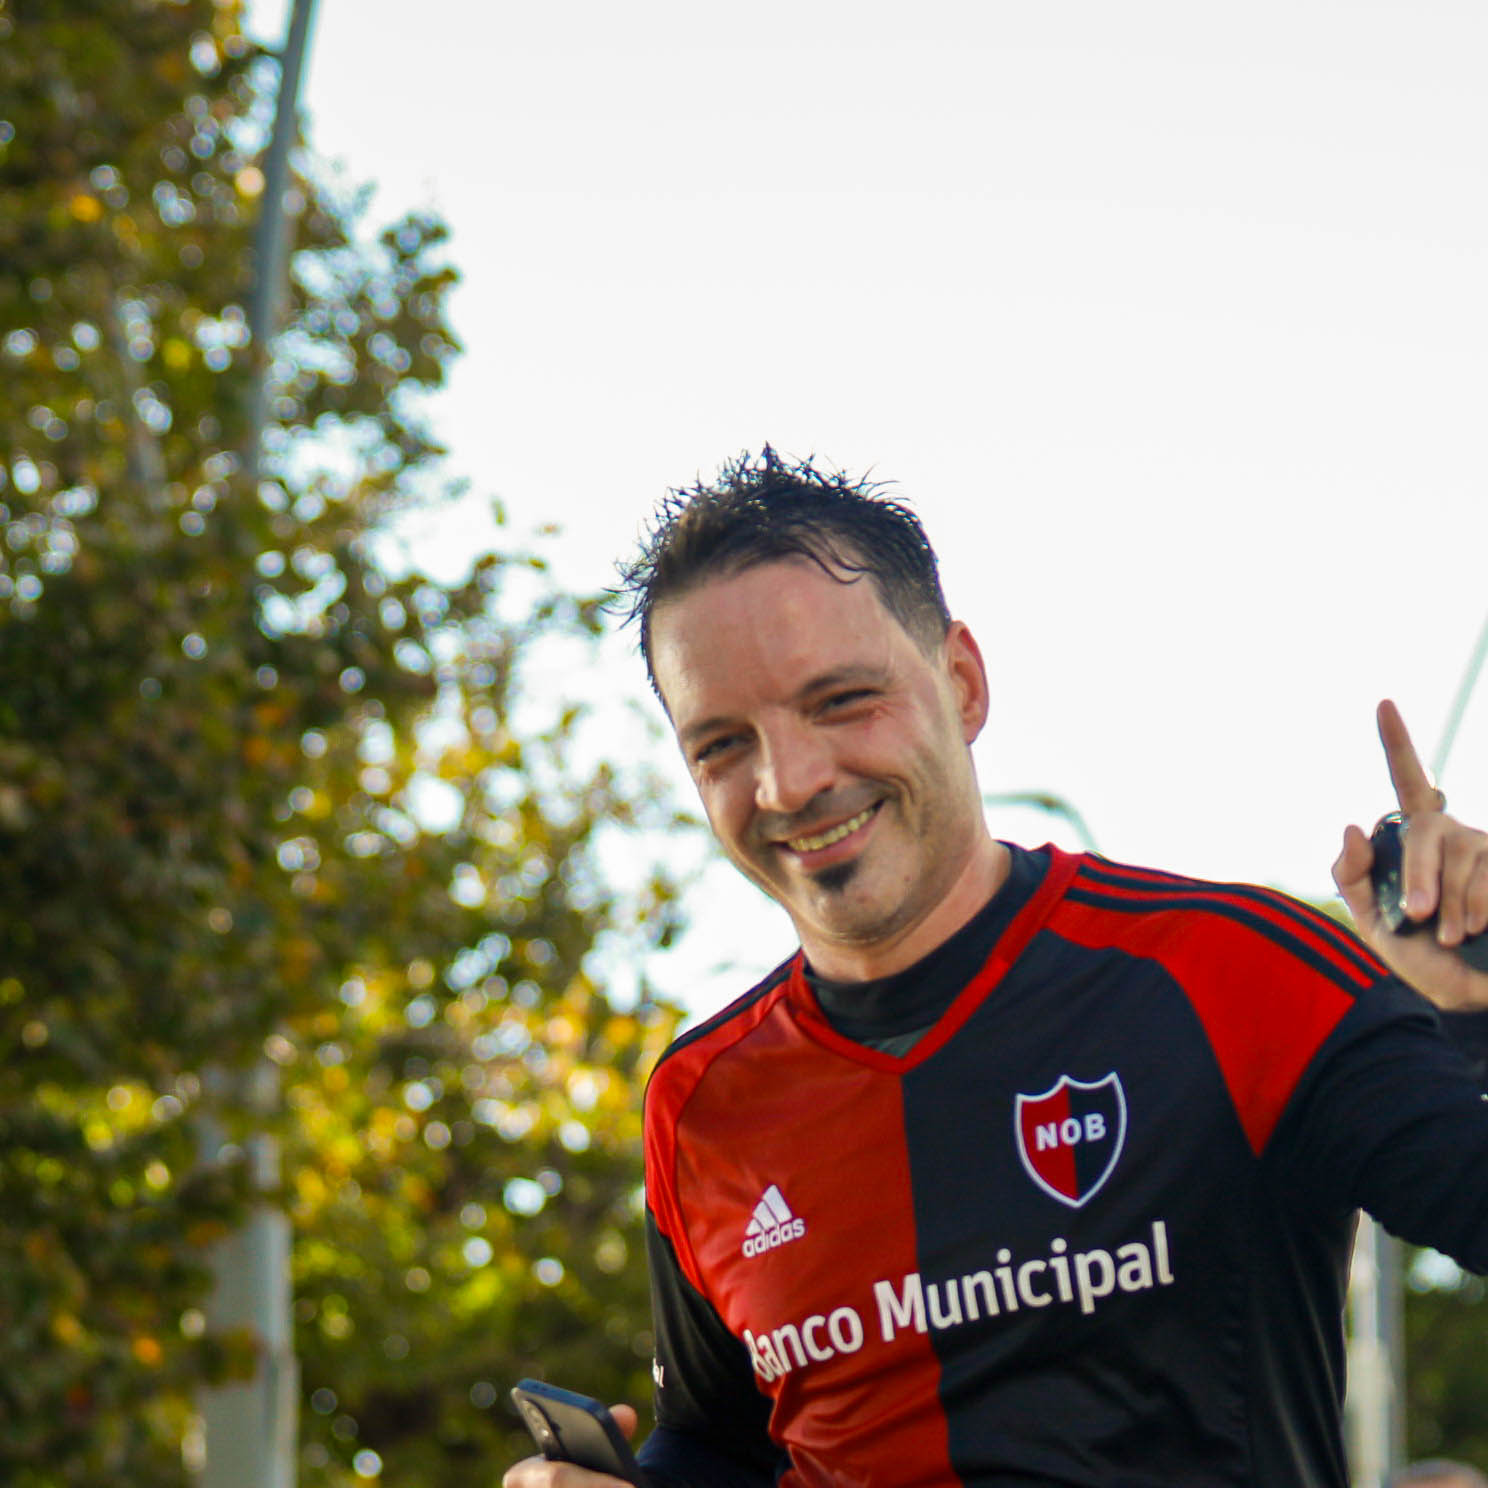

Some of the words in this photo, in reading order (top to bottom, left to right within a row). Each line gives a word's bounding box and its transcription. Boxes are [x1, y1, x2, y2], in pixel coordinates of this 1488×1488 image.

[1035, 1112, 1107, 1152] NOB
[742, 1218, 806, 1258] adidas
[873, 1220, 1175, 1343] Municipal
